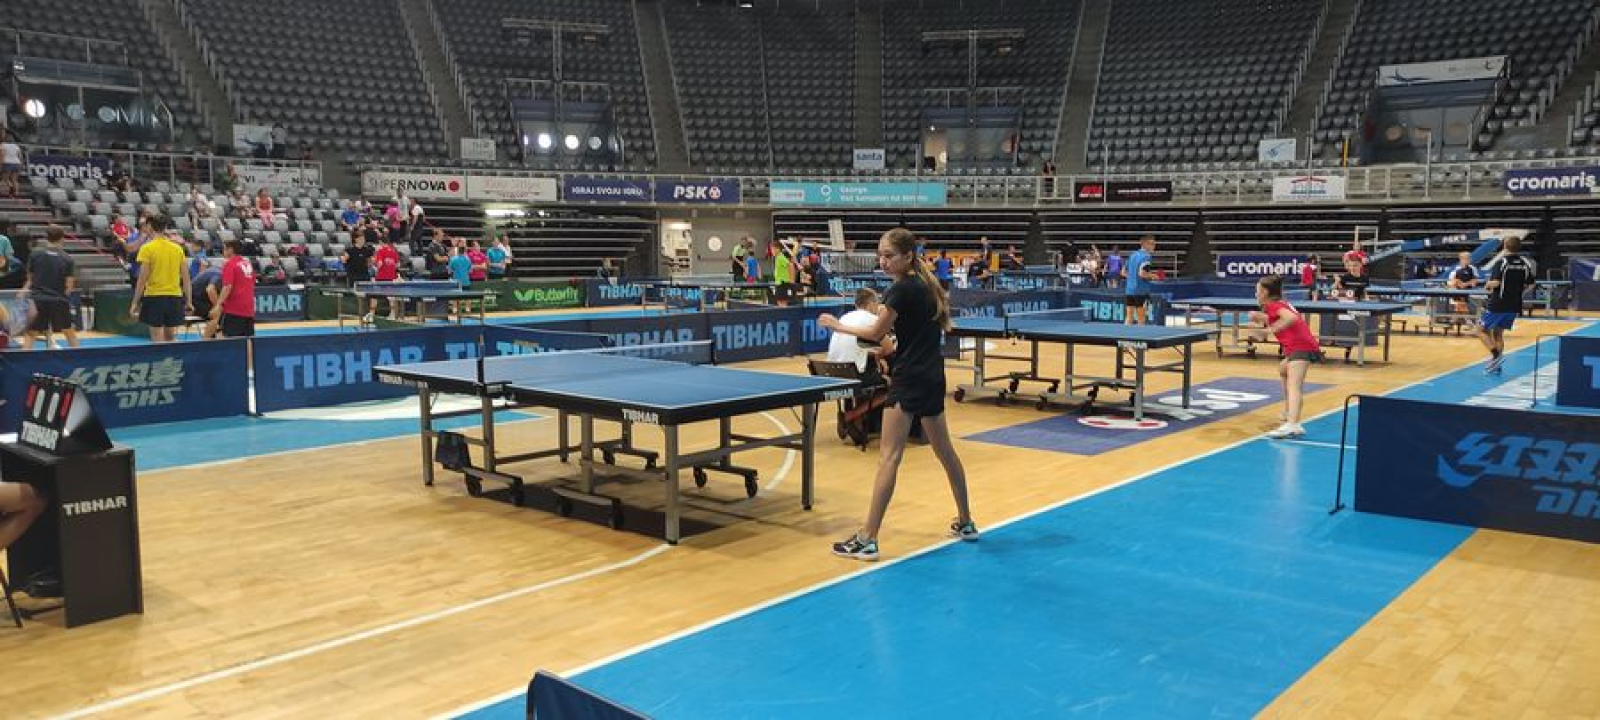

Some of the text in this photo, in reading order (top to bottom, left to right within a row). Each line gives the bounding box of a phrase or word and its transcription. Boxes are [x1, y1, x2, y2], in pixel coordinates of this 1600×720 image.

[1508, 171, 1595, 190] cromaris
[674, 185, 707, 199] PSK
[712, 321, 790, 351] TIBHAR
[115, 387, 183, 410] DHS
[62, 495, 128, 517] TIBHAR
